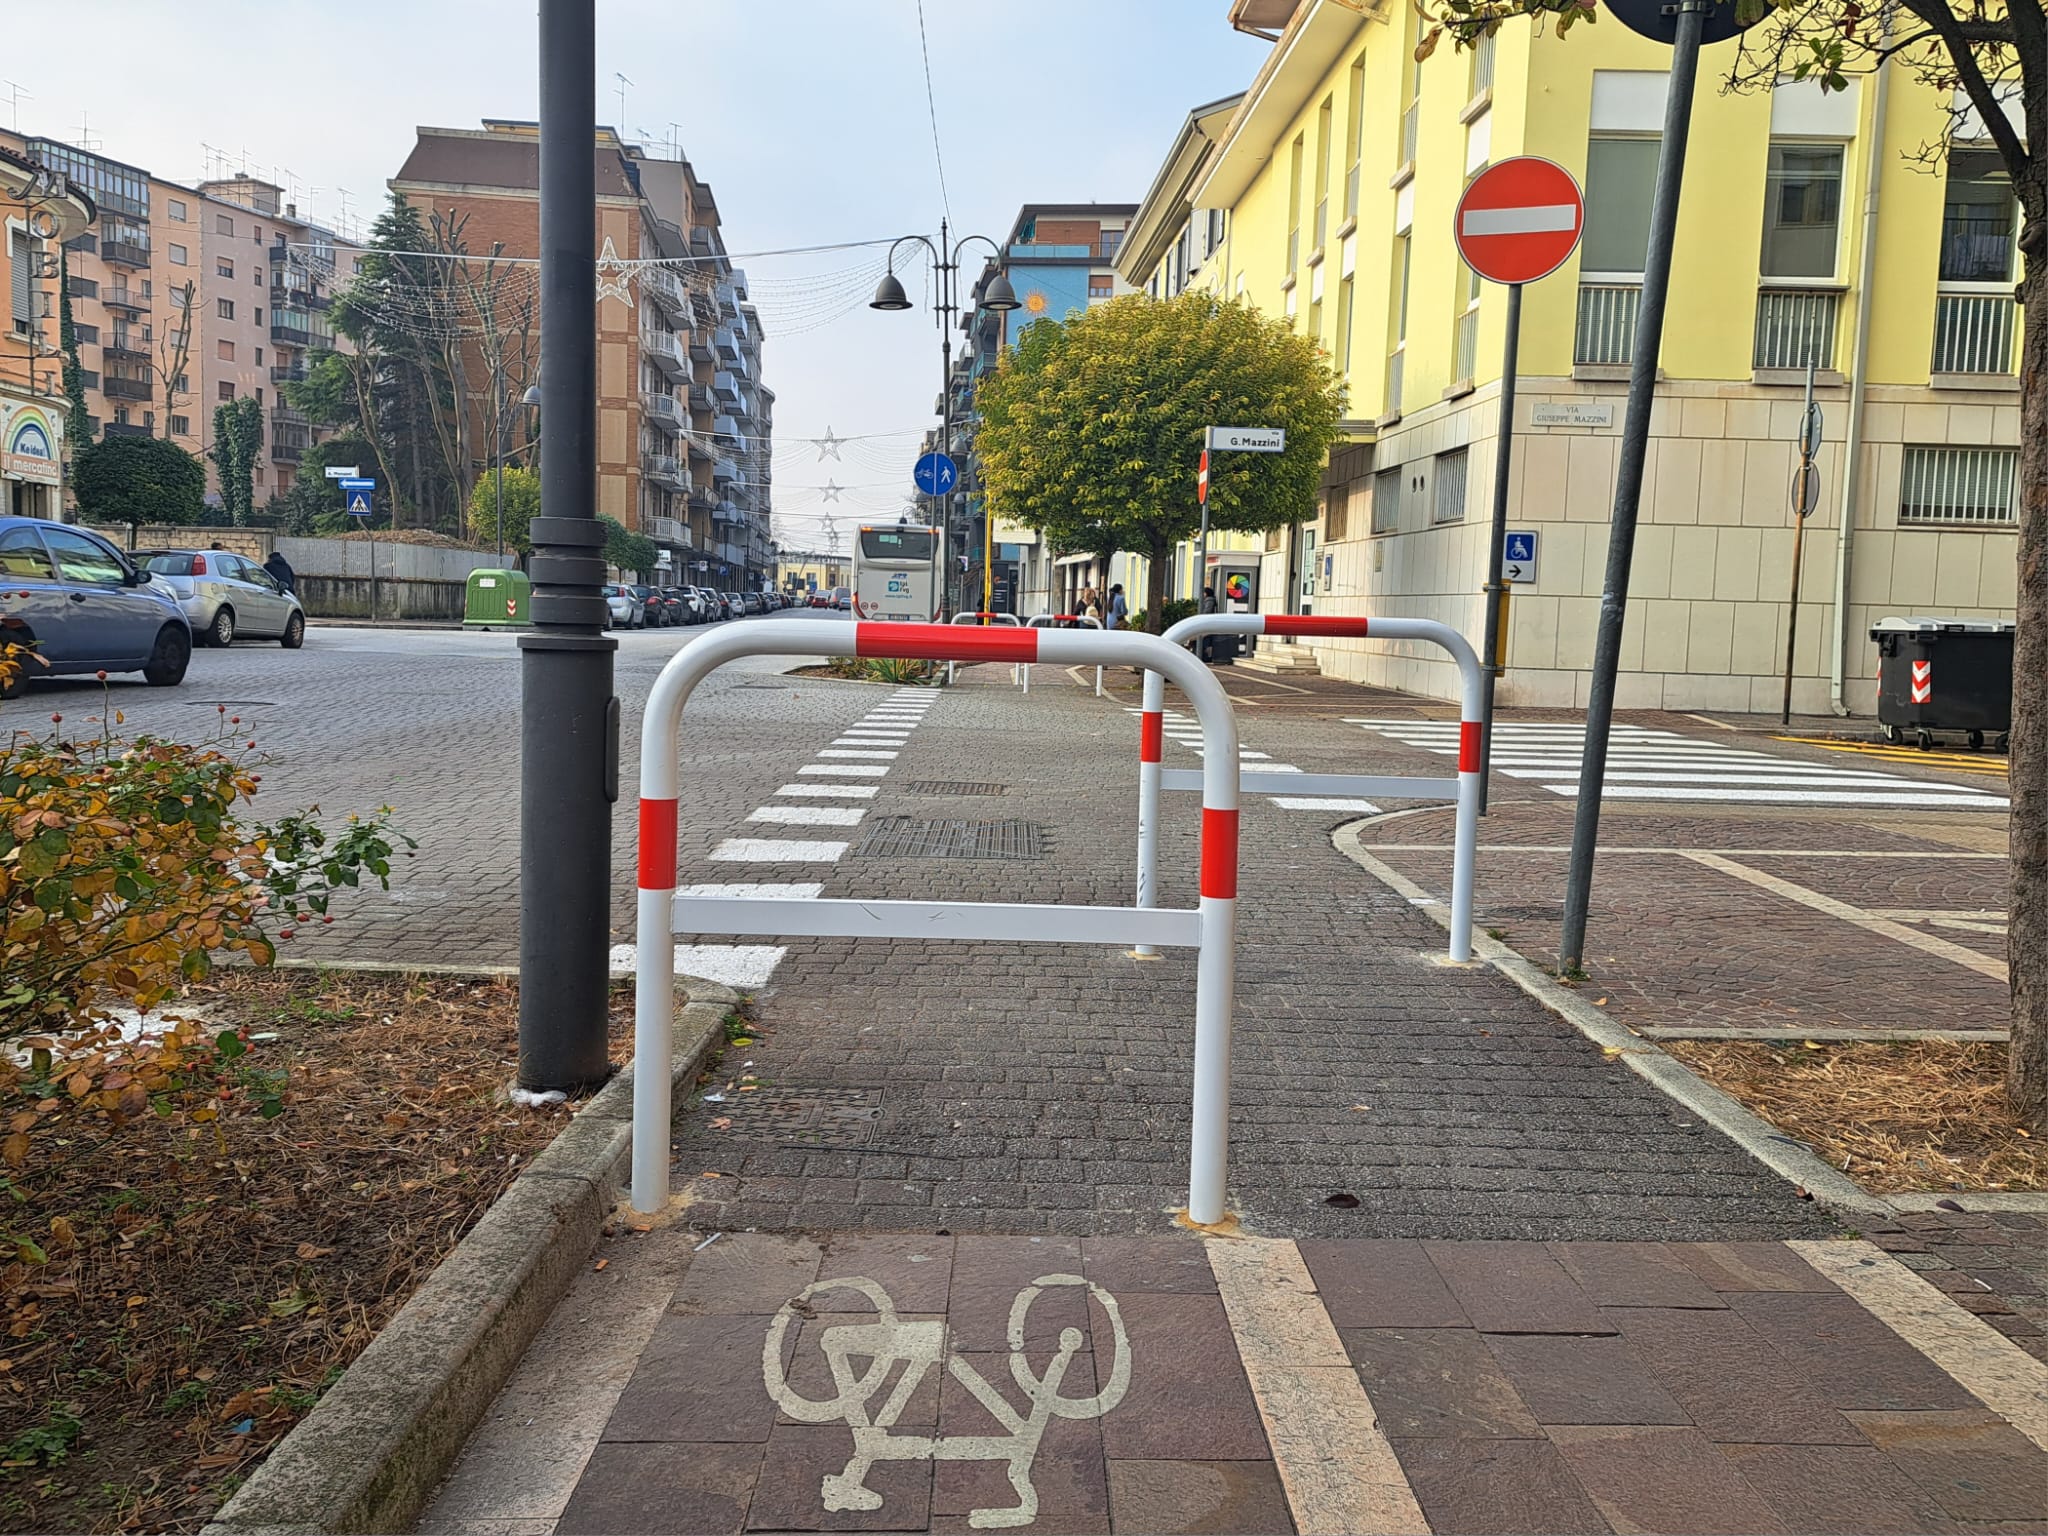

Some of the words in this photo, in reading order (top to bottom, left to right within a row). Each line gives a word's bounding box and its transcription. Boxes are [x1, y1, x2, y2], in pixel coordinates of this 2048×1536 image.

[1566, 406, 1579, 414] VIA
[1536, 415, 1568, 423] GIUSEPPE
[1574, 415, 1607, 424] MAZZINI
[13, 459, 57, 478] mercatino
